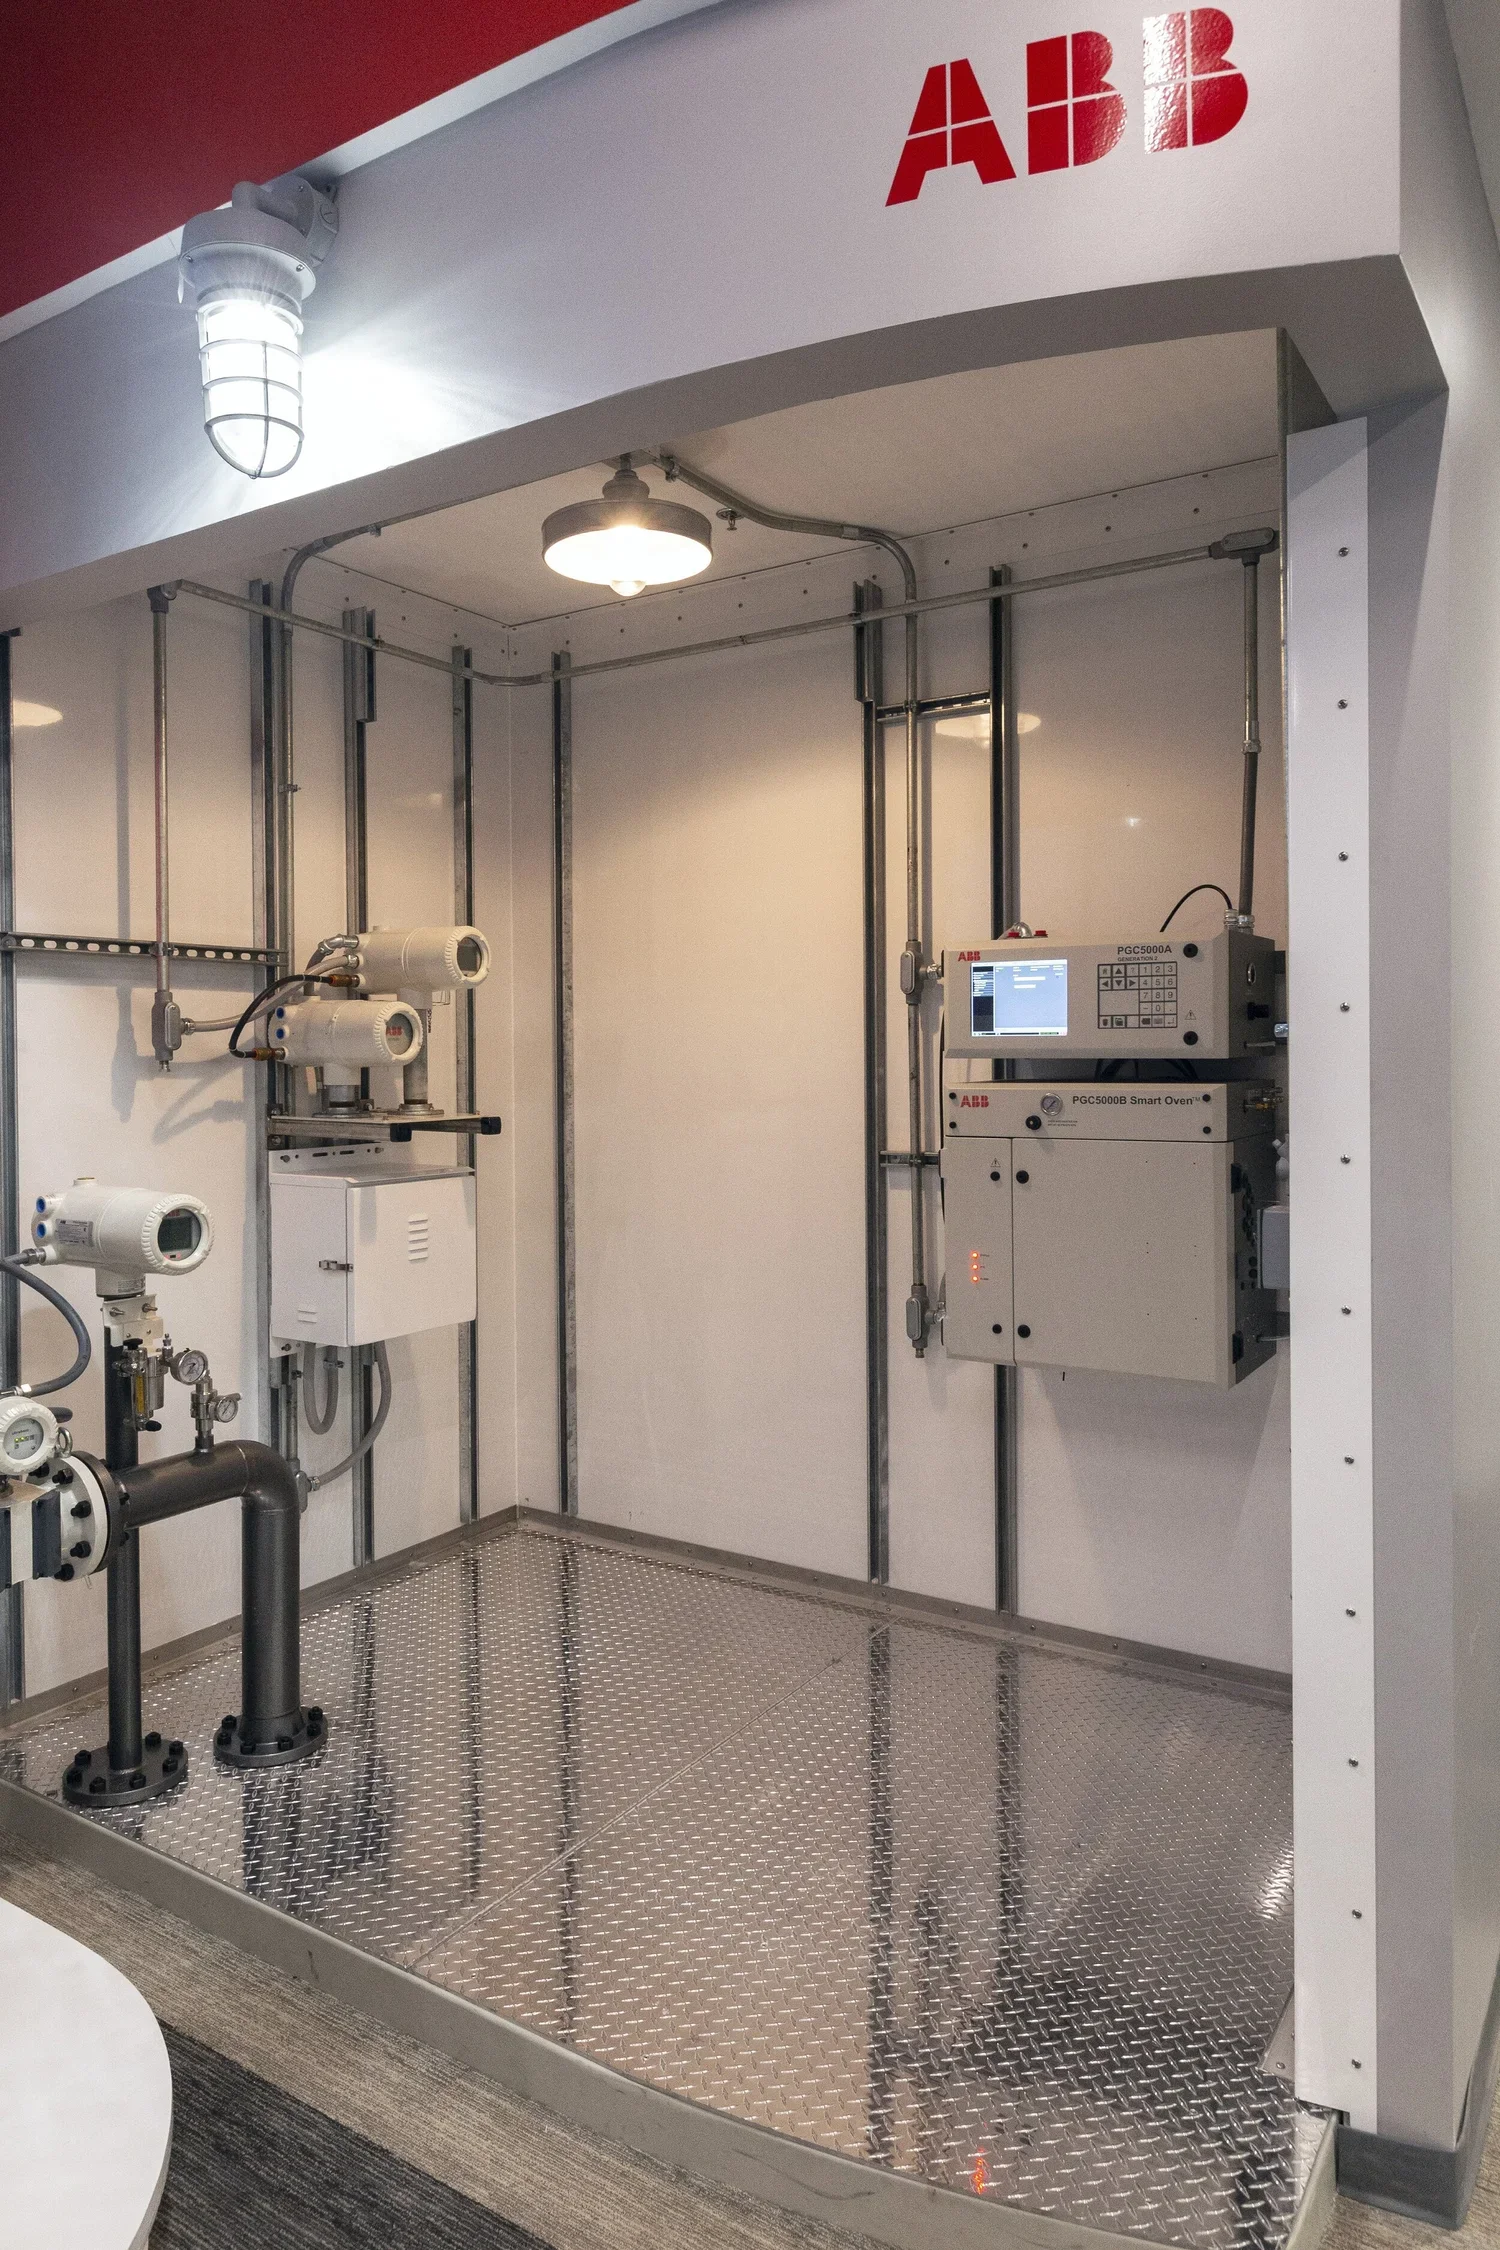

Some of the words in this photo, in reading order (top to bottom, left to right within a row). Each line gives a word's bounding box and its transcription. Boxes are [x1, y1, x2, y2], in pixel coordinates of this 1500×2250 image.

[885, 7, 1248, 207] ABB
[1117, 945, 1172, 955] PGC5000A
[957, 951, 981, 962] ABB
[1155, 965, 1161, 973] 2
[1167, 965, 1173, 973] 3
[1155, 978, 1161, 986] 5
[1167, 978, 1173, 986] 6
[1155, 991, 1161, 999] 8
[1167, 991, 1173, 999] 9
[1155, 1004, 1161, 1012] 0
[960, 1095, 989, 1108] ABB
[1072, 1095, 1127, 1105] PGC5000B
[1130, 1095, 1161, 1105] Smart
